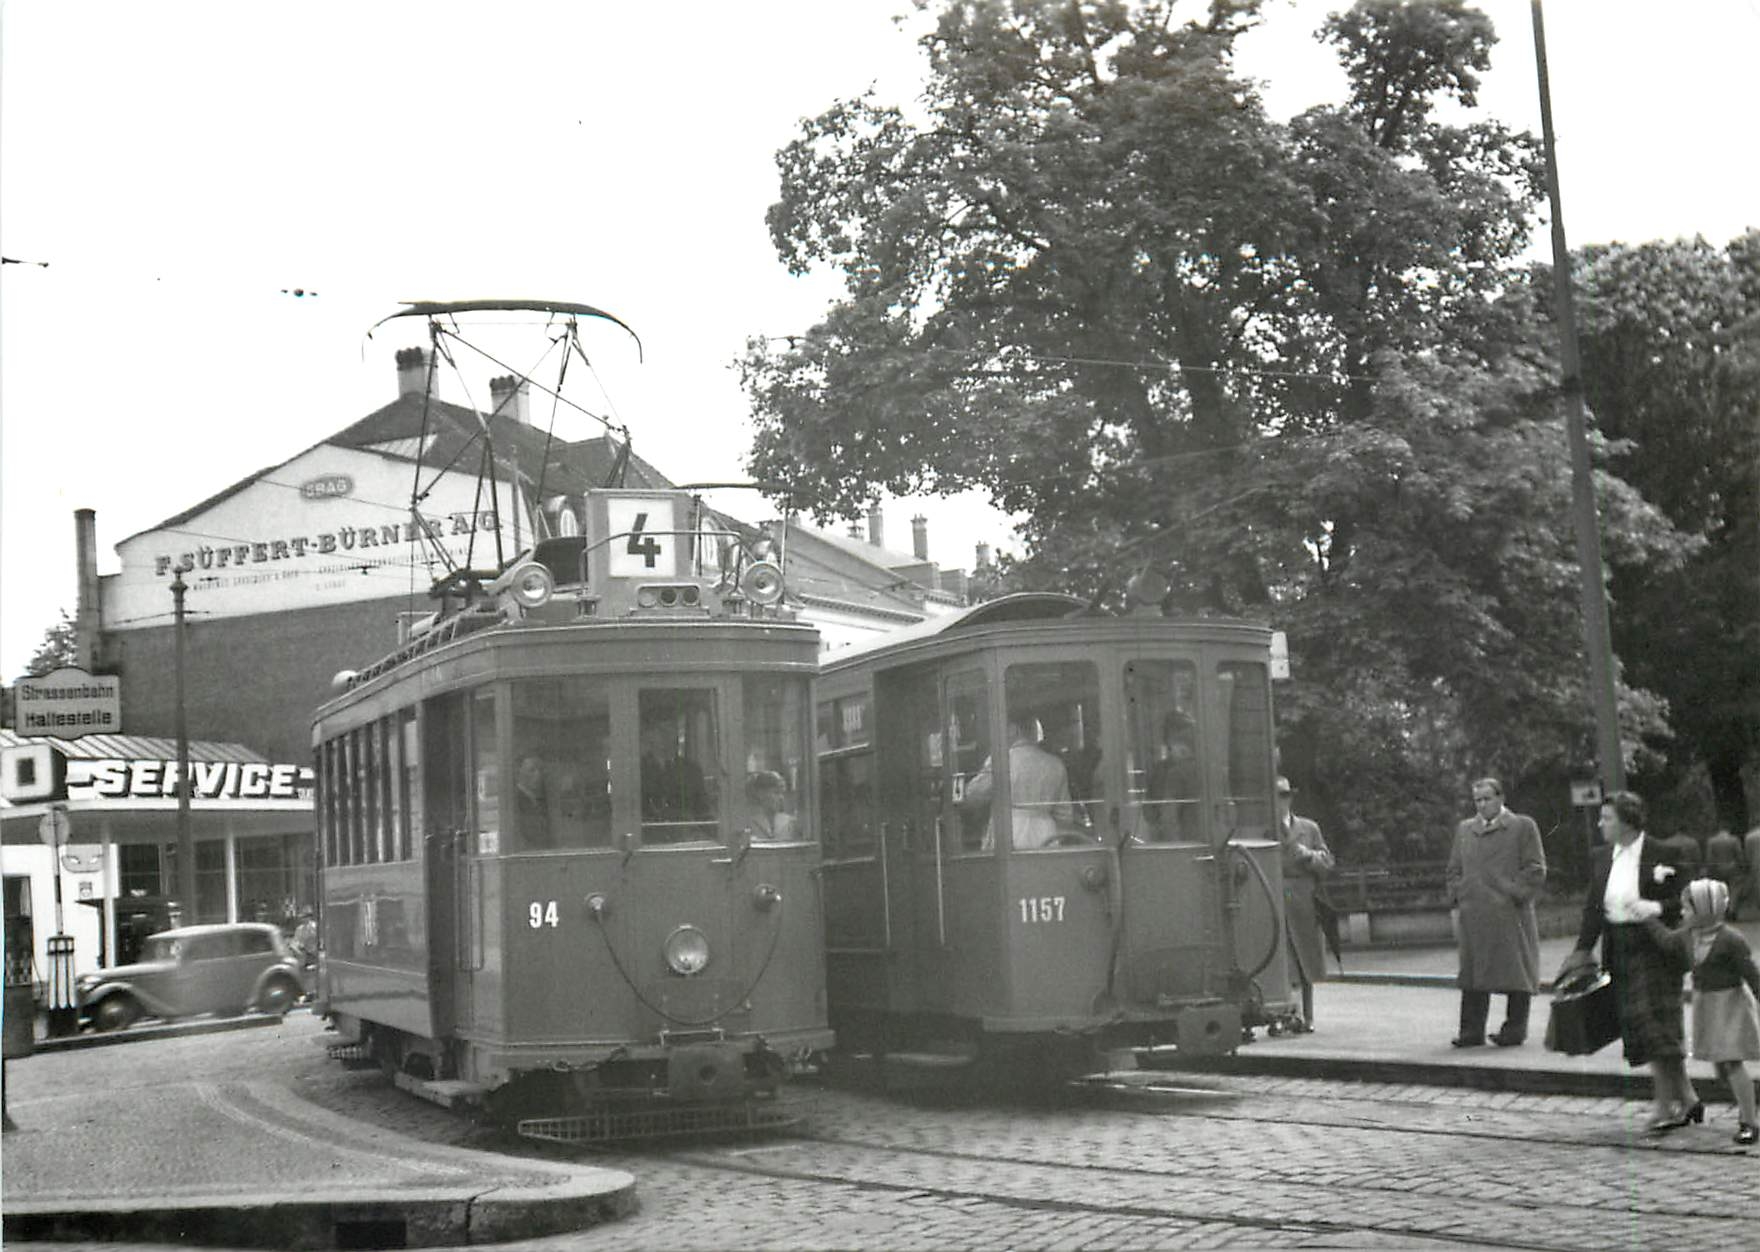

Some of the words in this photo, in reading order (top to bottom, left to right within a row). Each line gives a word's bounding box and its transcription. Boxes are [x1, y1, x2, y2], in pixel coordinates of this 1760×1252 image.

[627, 513, 661, 568] 4
[22, 682, 114, 700] Strassenbahn
[26, 708, 111, 727] Haltestelle
[529, 900, 559, 928] 94
[1019, 896, 1065, 924] 1157
